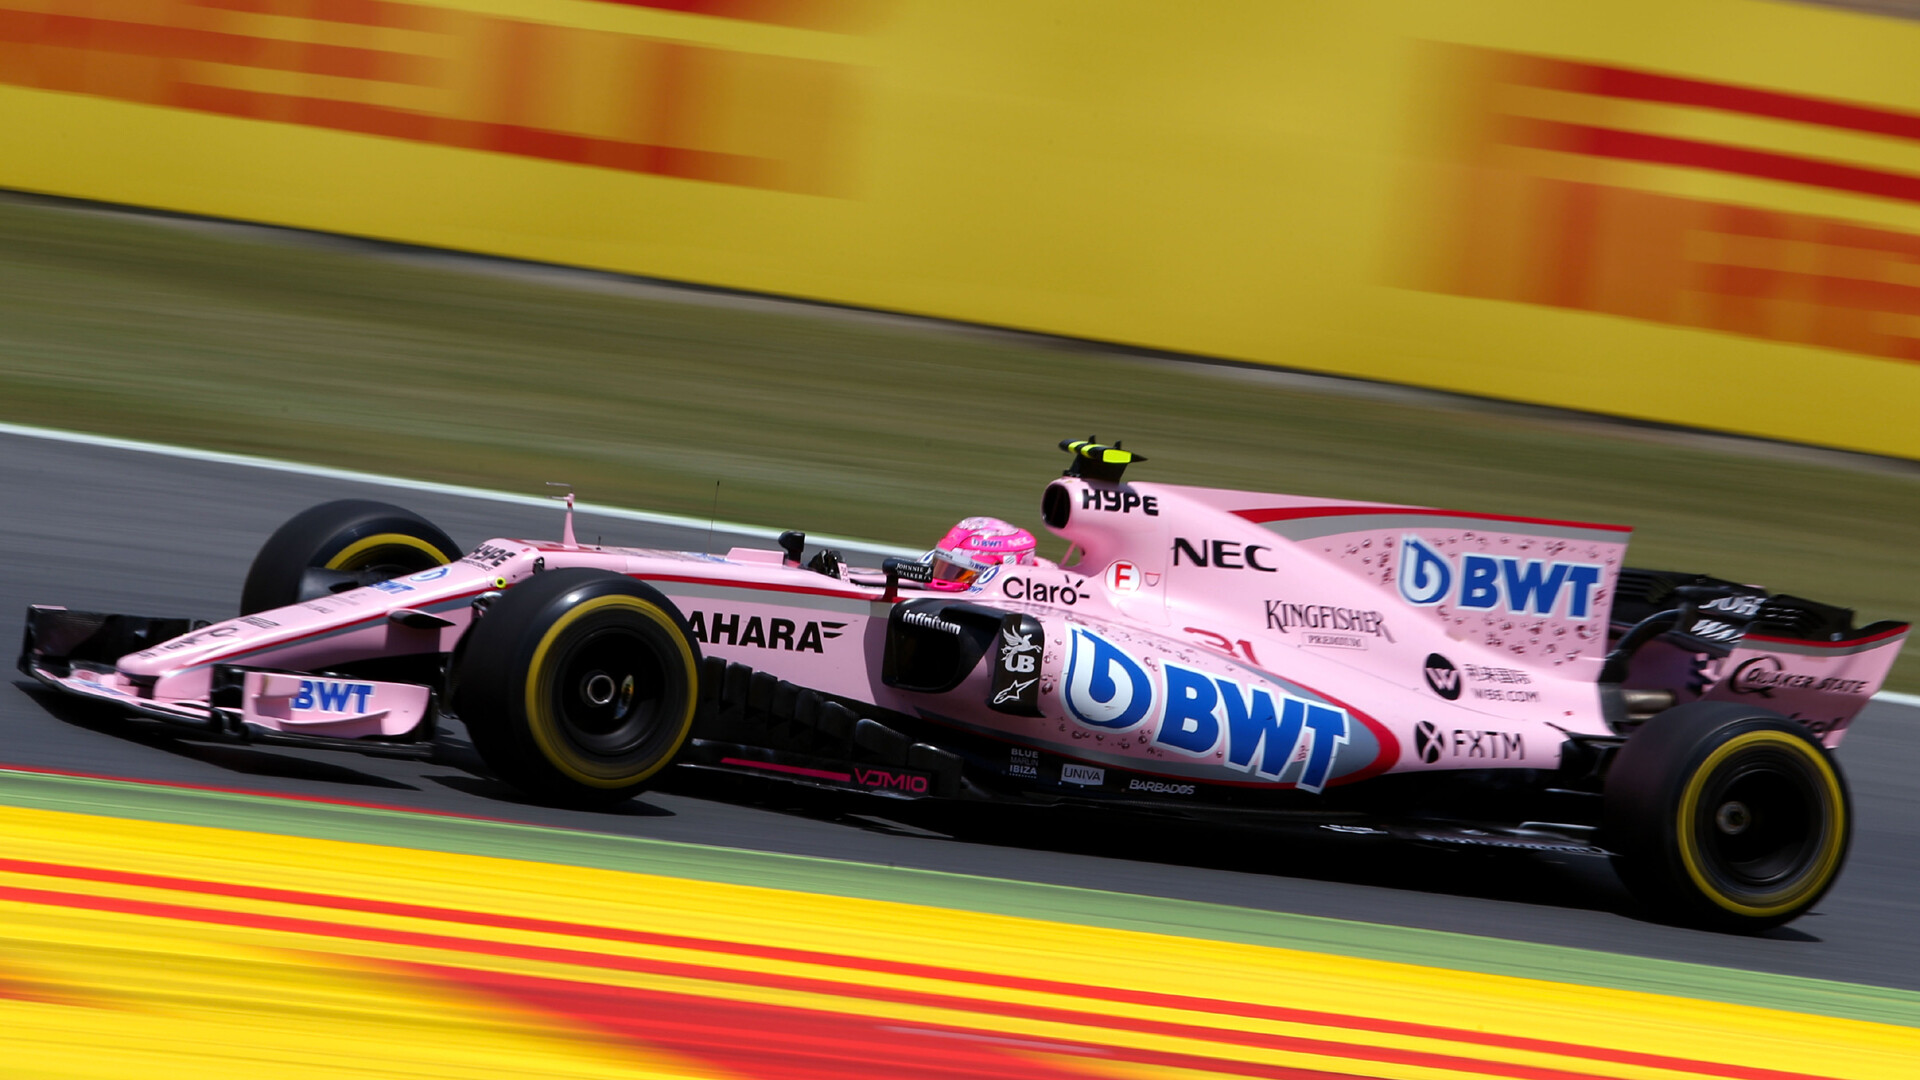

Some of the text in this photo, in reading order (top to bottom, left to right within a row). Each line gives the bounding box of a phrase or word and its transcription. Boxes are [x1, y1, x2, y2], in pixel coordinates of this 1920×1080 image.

[1081, 488, 1159, 516] HYPE
[1172, 537, 1279, 572] NEC
[1002, 575, 1090, 606] Claro
[1457, 554, 1604, 620] BWT
[688, 609, 825, 655] AHARA
[902, 609, 962, 636] infinitum
[1263, 599, 1398, 644] KINGFISHER
[1308, 634, 1363, 648] PREMIUM
[290, 679, 374, 715] BWT
[1814, 676, 1869, 694] STATE
[1154, 658, 1350, 794] BWT
[1010, 747, 1039, 759] BLUE
[1452, 729, 1527, 761] FXTM
[1008, 764, 1038, 776] IBIZA
[1010, 755, 1039, 767] MARLIN
[1063, 766, 1101, 782] UNIVA
[1128, 778, 1197, 796] BARBADOS
